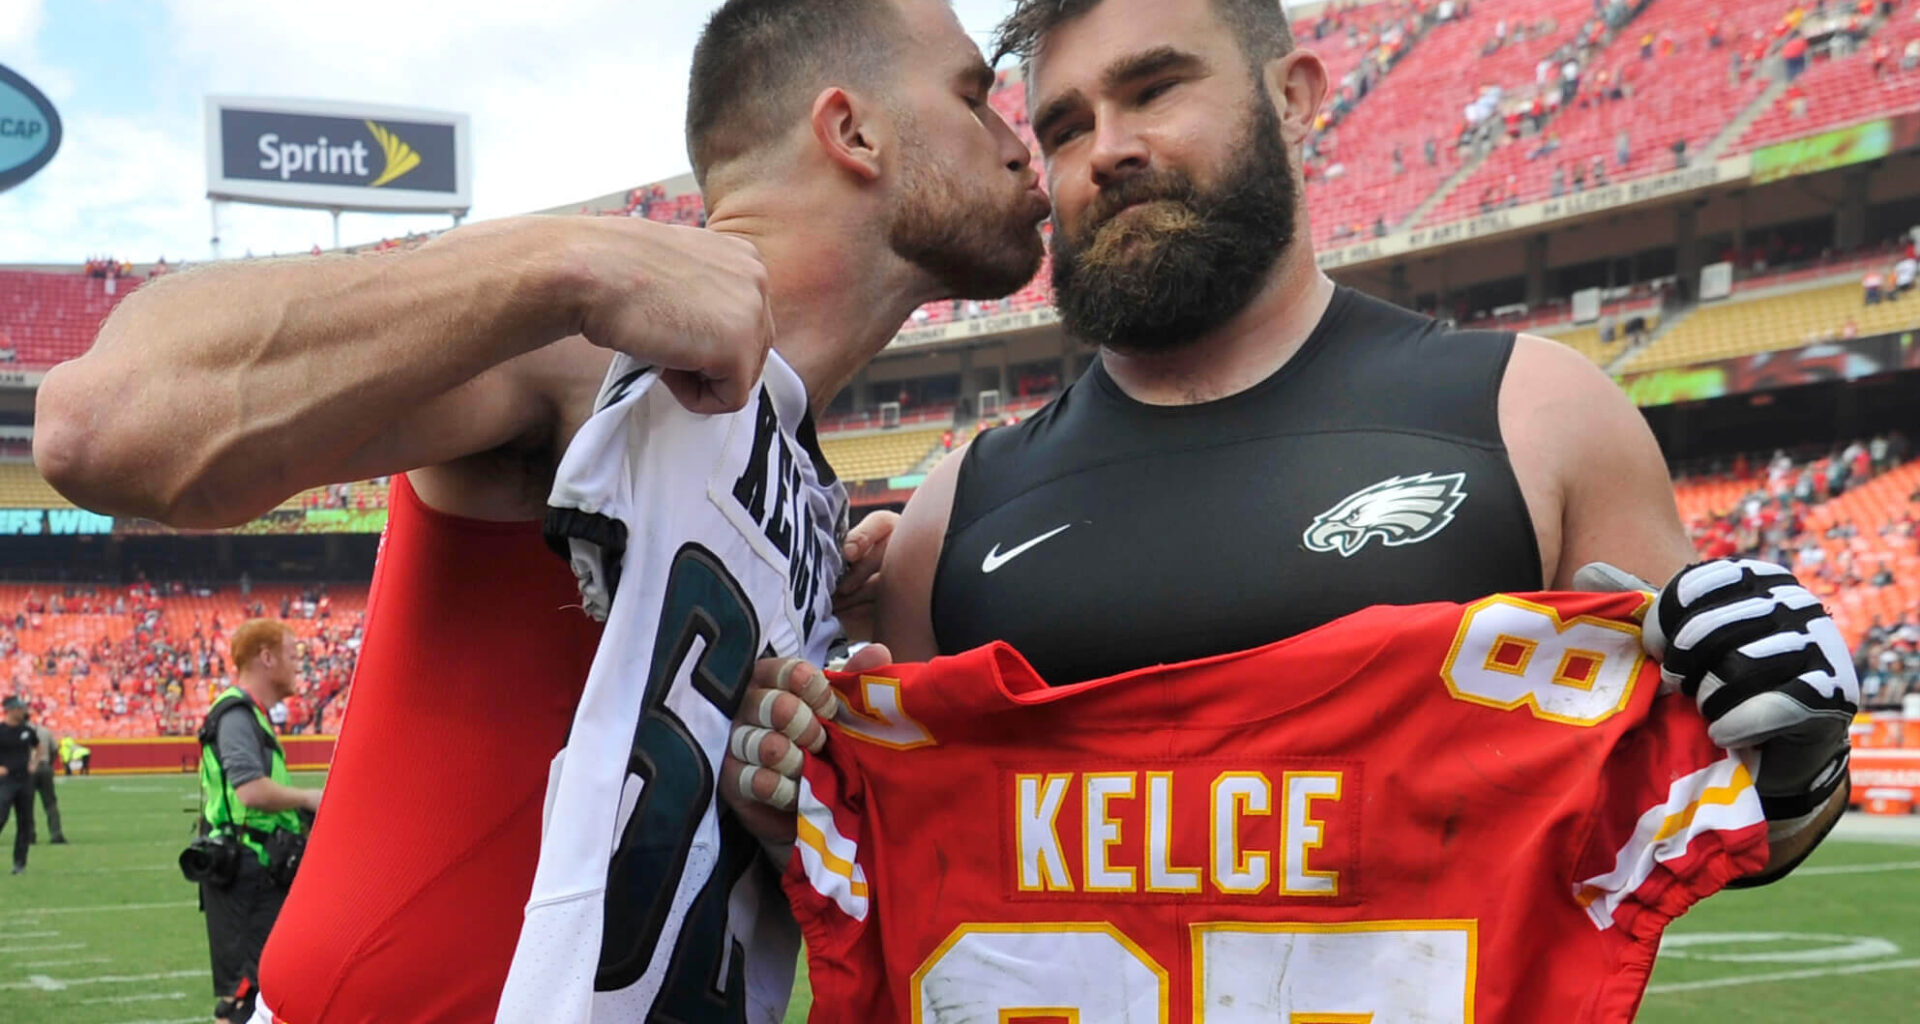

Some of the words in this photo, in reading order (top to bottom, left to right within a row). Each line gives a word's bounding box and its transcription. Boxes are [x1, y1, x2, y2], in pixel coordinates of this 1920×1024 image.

[258, 132, 369, 180] Sprint
[732, 382, 826, 646] KELCE
[1014, 770, 1343, 896] KELCE
